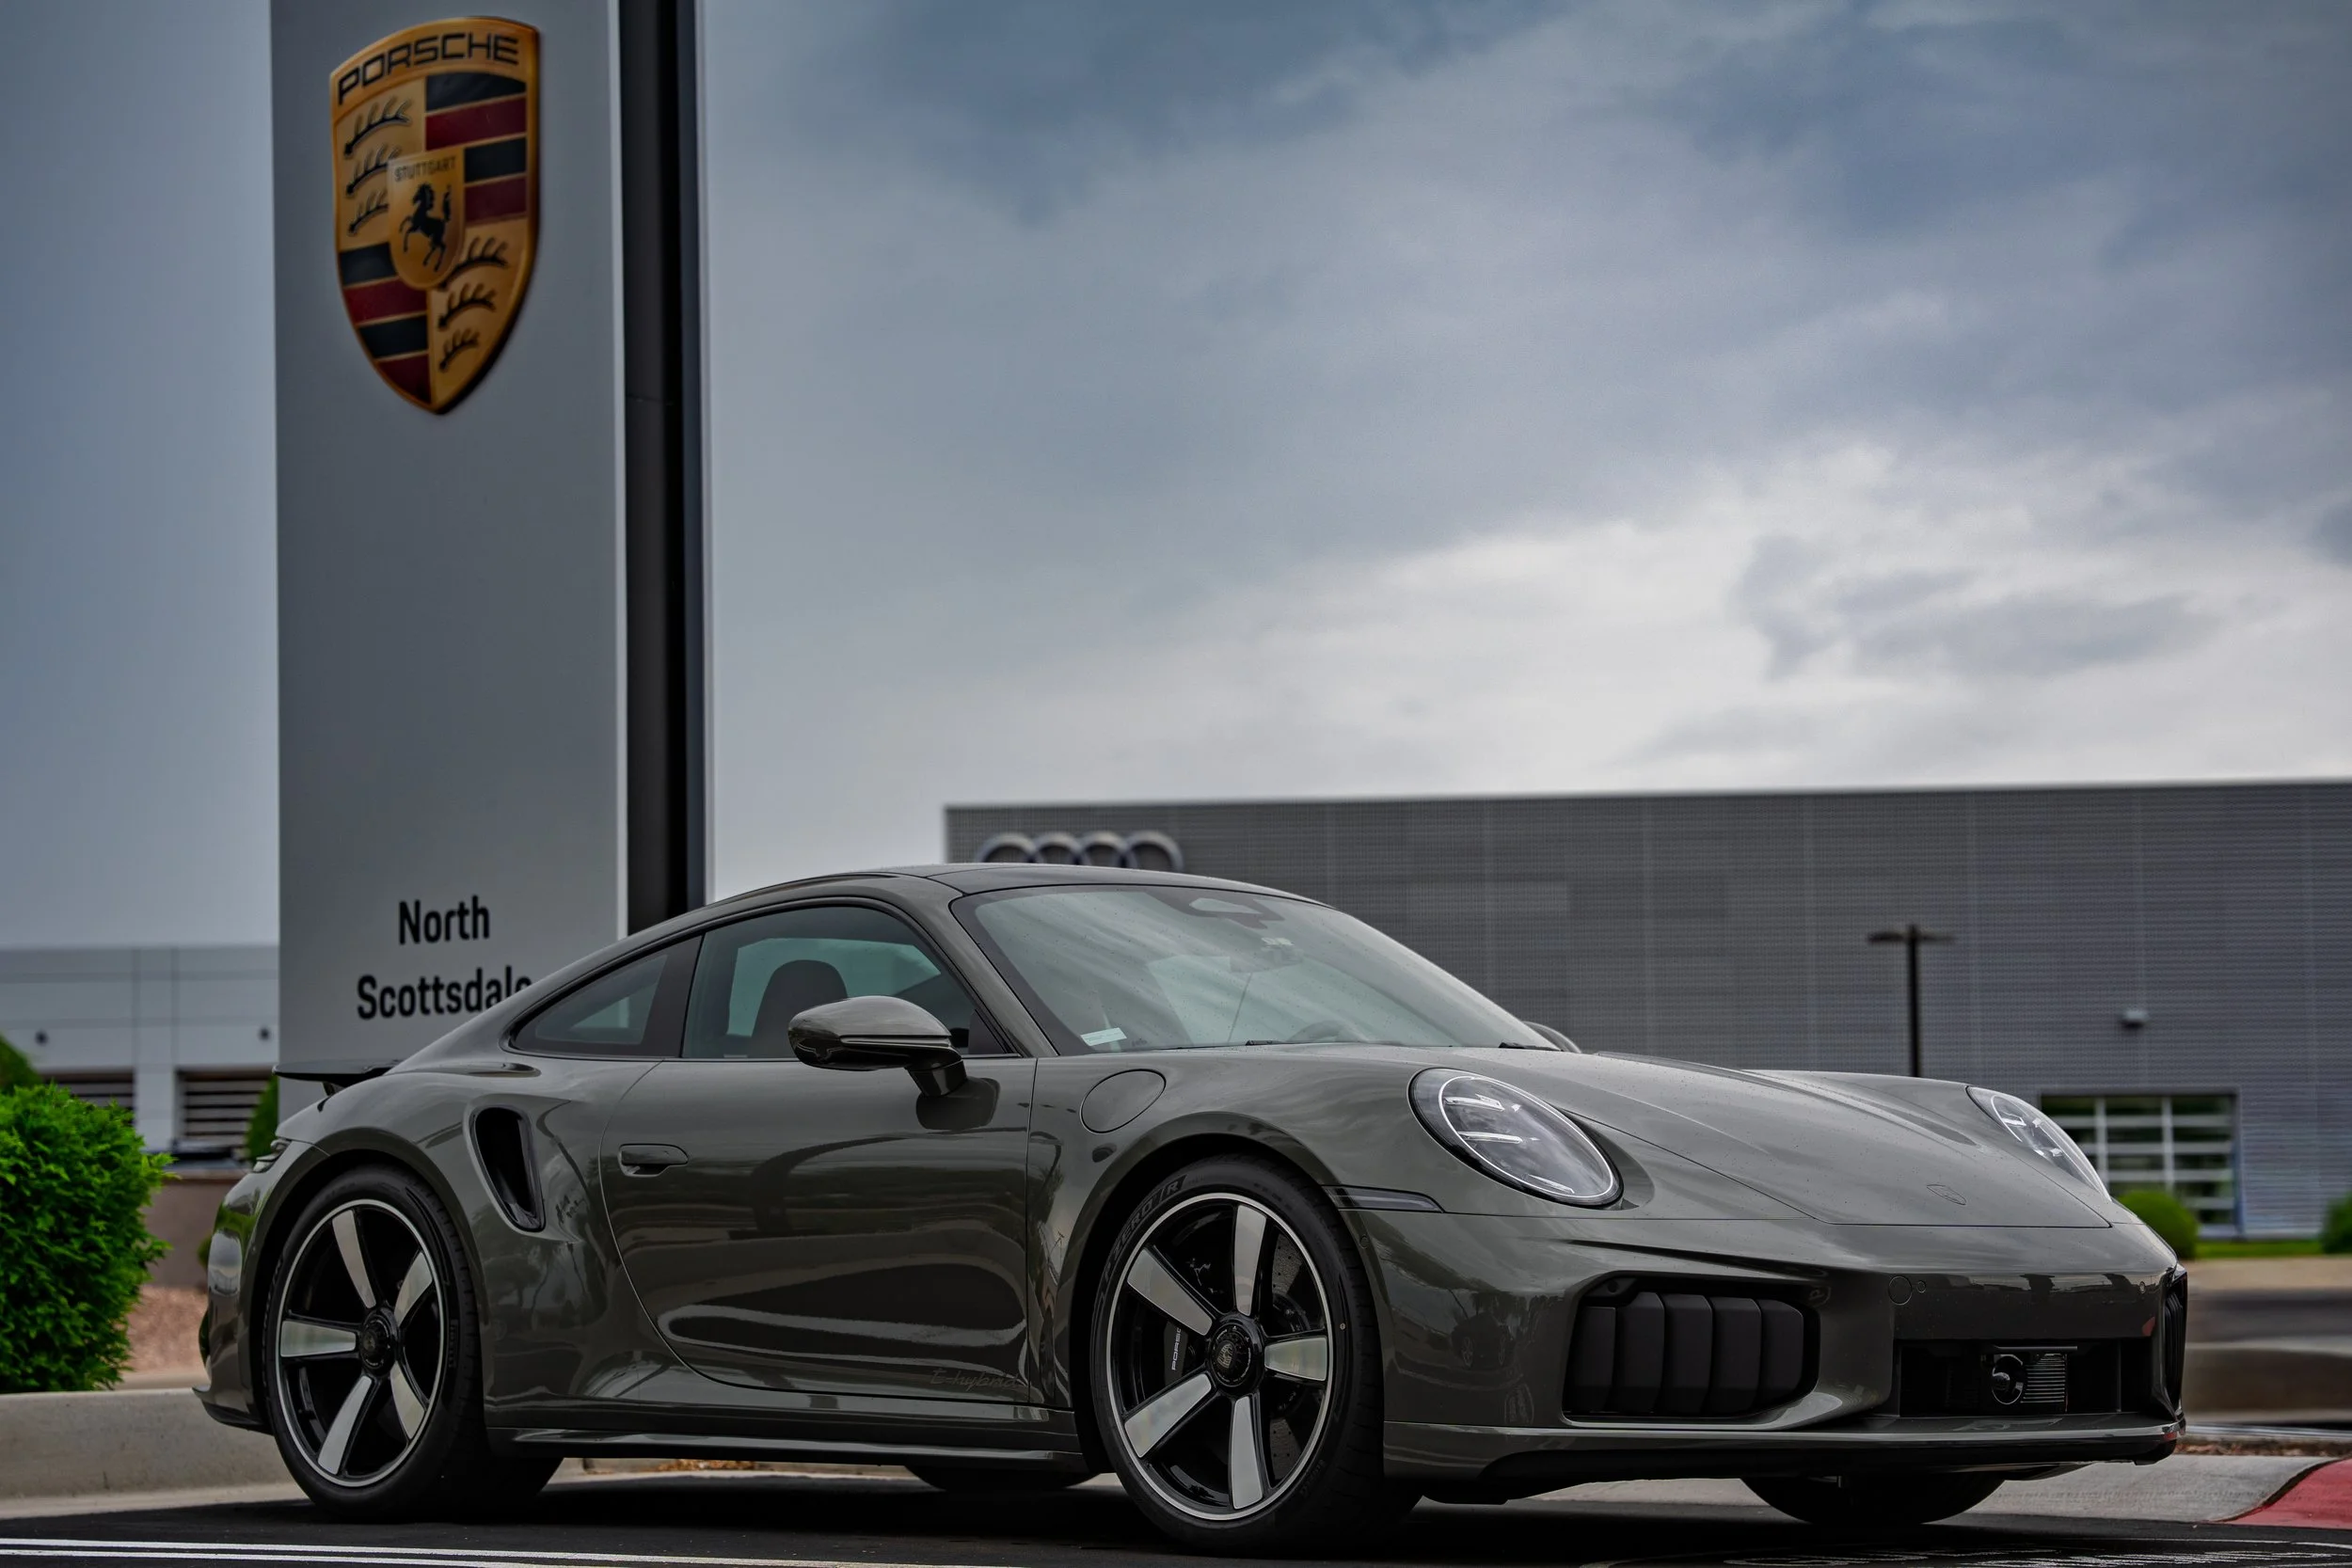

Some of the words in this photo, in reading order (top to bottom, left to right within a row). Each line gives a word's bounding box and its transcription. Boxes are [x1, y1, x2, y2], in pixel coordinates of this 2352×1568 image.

[338, 32, 519, 105] PORSCHE
[395, 156, 456, 182] STUTTGART
[399, 895, 489, 944] North
